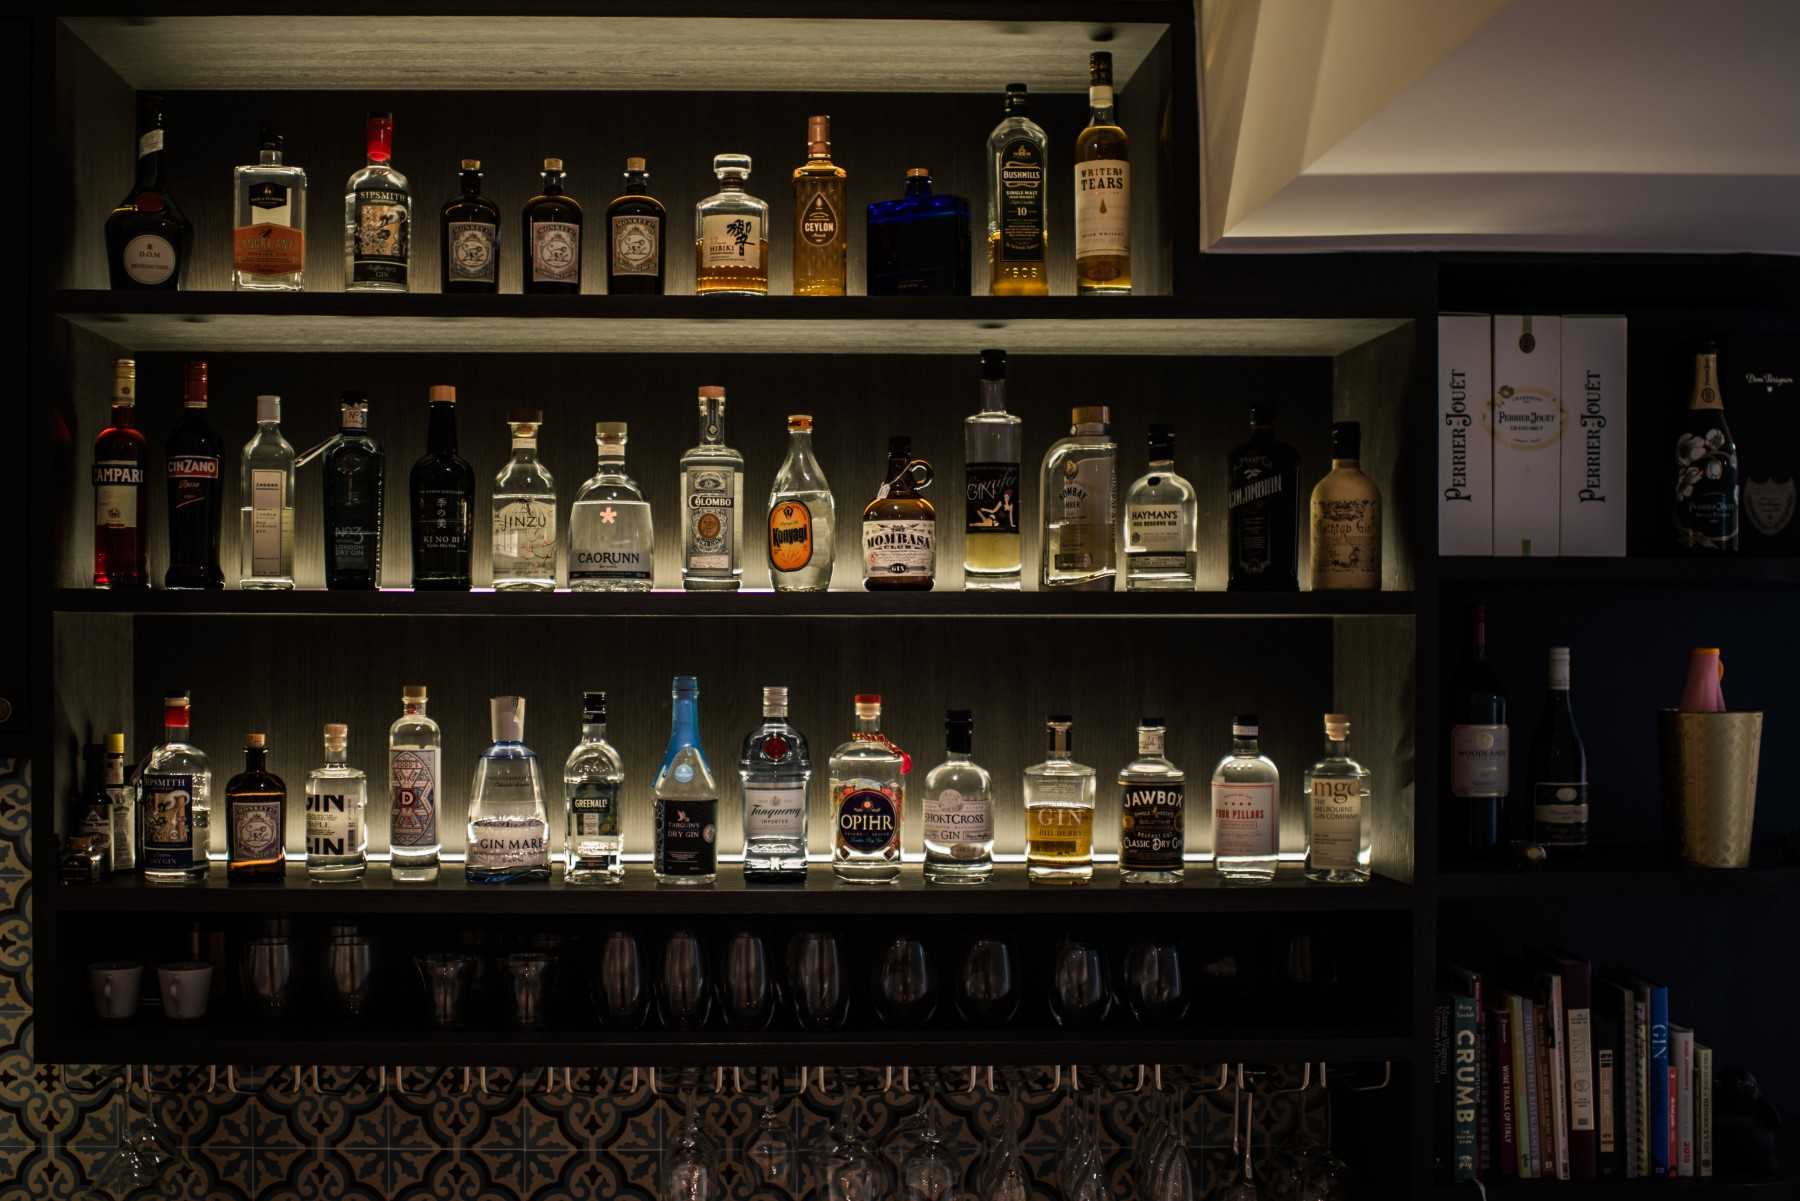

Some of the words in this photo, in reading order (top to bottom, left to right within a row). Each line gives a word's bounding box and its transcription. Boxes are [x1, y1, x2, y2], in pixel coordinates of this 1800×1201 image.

[1003, 171, 1041, 180] BUSHMILLS
[1081, 177, 1123, 191] TEARS
[1017, 207, 1028, 216] 10
[804, 223, 834, 232] CEYLON
[168, 458, 216, 473] CINZANO
[688, 493, 733, 510] COLOMBO
[1131, 510, 1179, 520] HAYMAN'S
[501, 515, 547, 532] JINZU
[866, 533, 931, 549] MOMBASA
[577, 552, 640, 565] CAORUNN
[401, 793, 414, 806] D
[1124, 790, 1184, 809] JAWBOX
[750, 805, 802, 818] Tanqueray
[1038, 808, 1083, 826] GIN
[1232, 809, 1264, 819] PILLARS
[840, 814, 894, 831] OPIHR
[686, 831, 700, 839] GIN
[940, 830, 960, 840] GIN
[480, 838, 505, 849] GIN
[1124, 838, 1150, 849] CLASSIC
[1152, 838, 1170, 851] DRY
[1652, 1023, 1668, 1058] GIN
[1456, 1029, 1476, 1124] CRUMB
[1502, 1065, 1511, 1086] WINE
[1503, 1086, 1512, 1111] TRAILS
[1504, 1112, 1512, 1122] OF
[1504, 1123, 1513, 1144] ITALY
